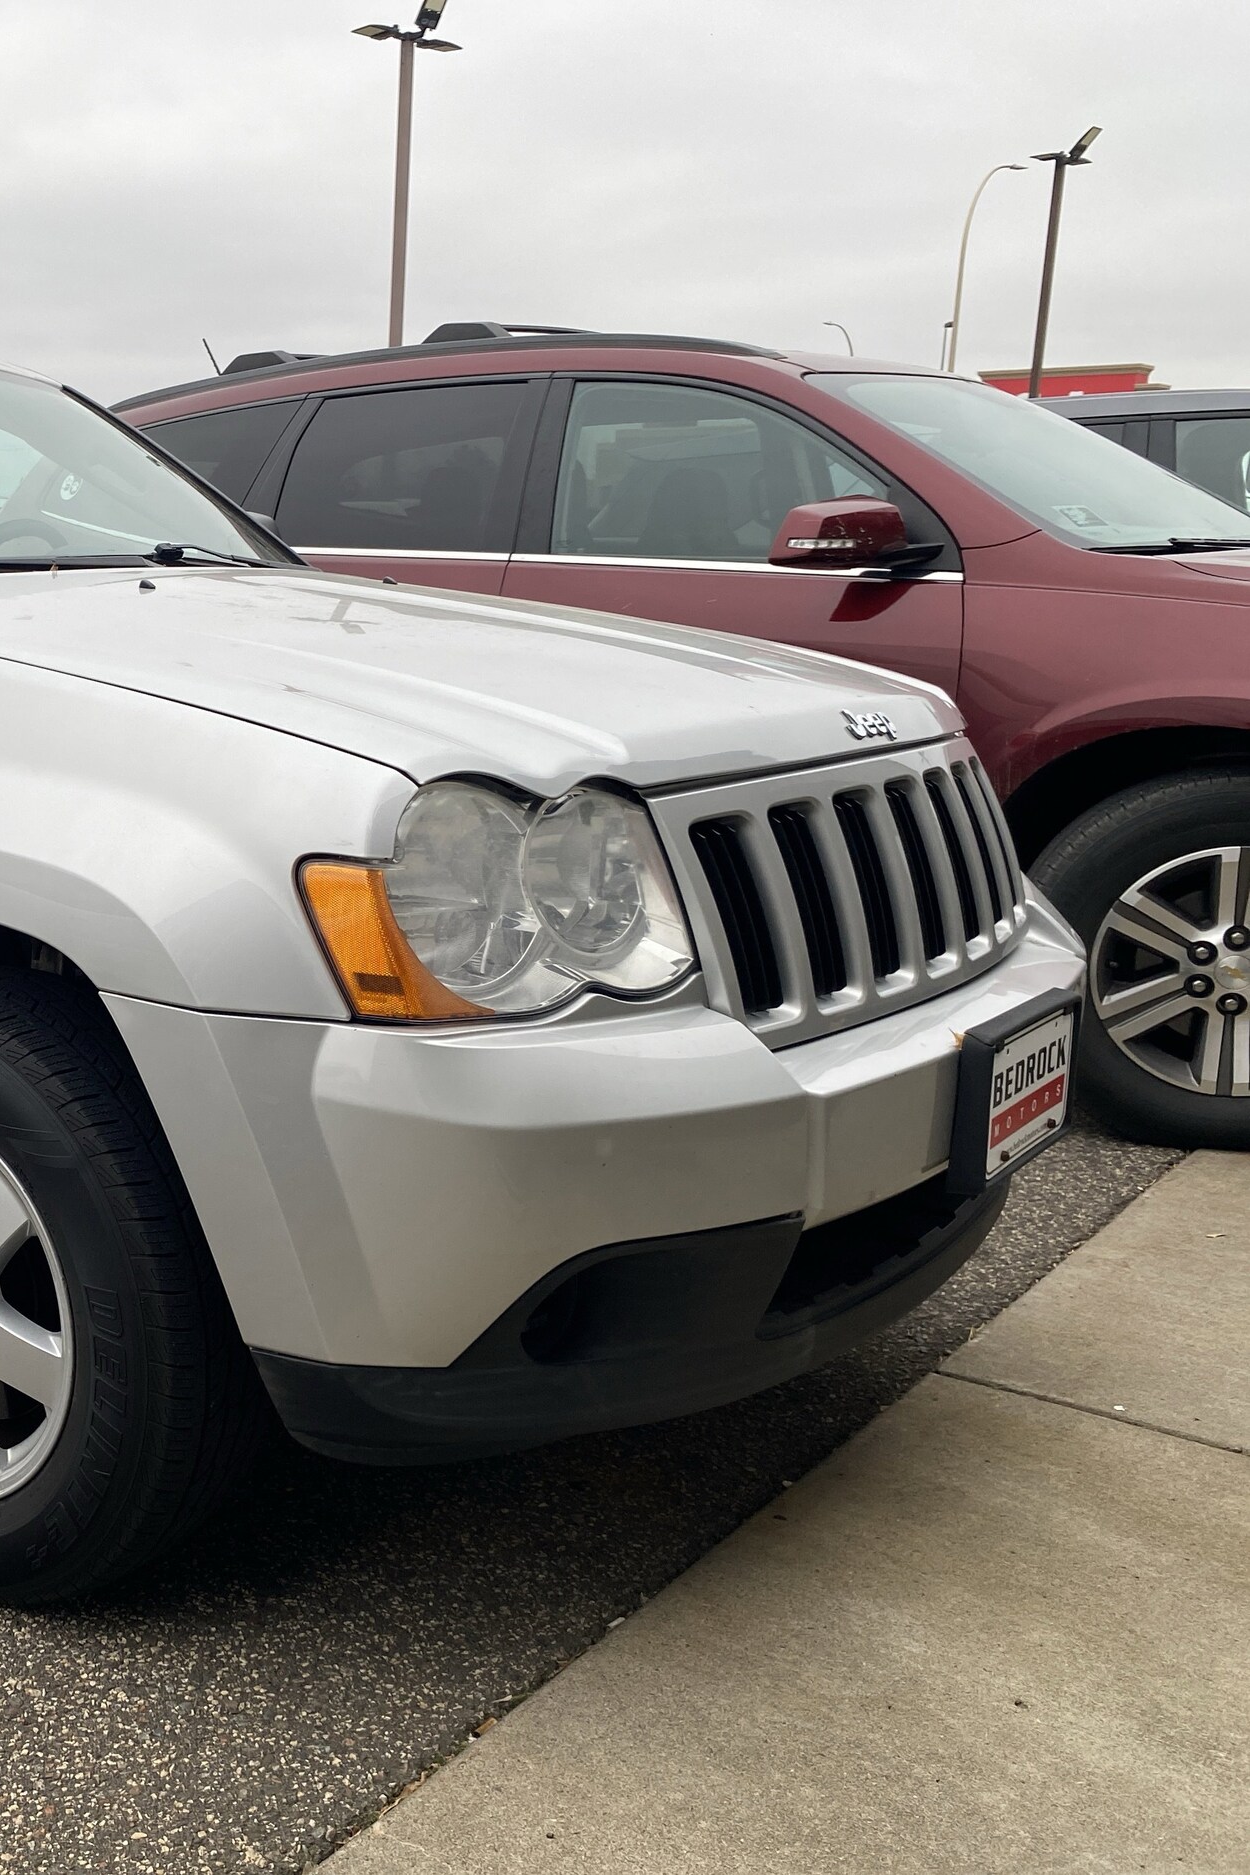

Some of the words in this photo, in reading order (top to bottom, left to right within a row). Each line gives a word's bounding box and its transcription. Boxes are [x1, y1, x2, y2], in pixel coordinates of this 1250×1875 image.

[840, 708, 897, 741] Jeep
[993, 1035, 1067, 1109] BEDROCK
[994, 1088, 1062, 1138] MOTORS
